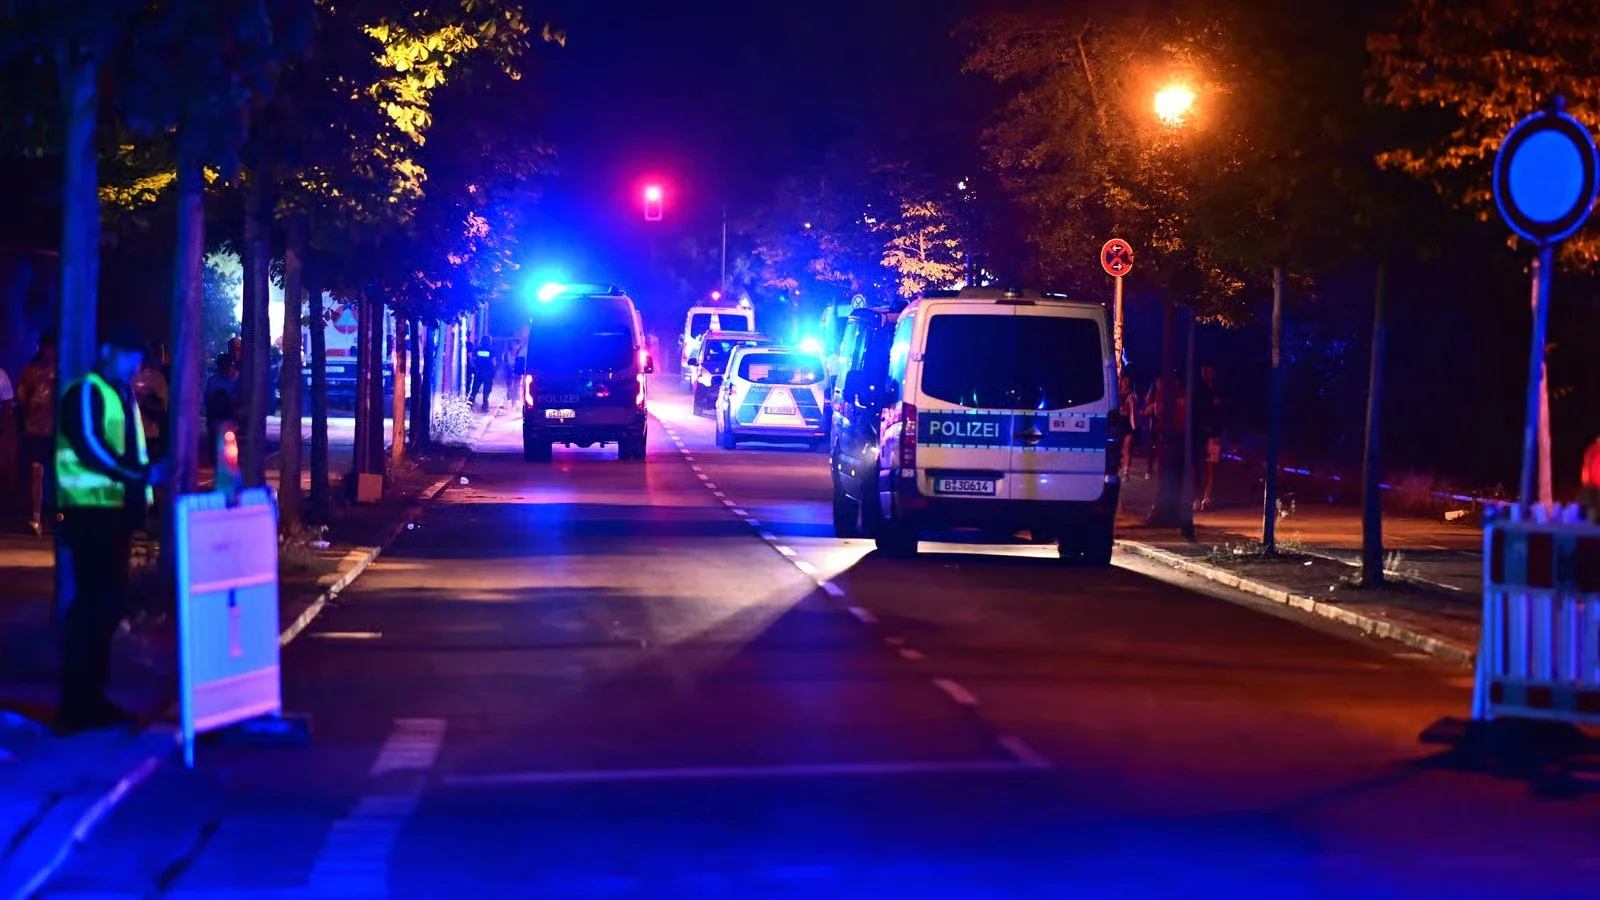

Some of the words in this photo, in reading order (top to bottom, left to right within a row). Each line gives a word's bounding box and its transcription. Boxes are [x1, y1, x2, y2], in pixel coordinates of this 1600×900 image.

[929, 420, 999, 438] POLIZEI
[1053, 419, 1065, 428] B1
[1074, 420, 1085, 429] 42
